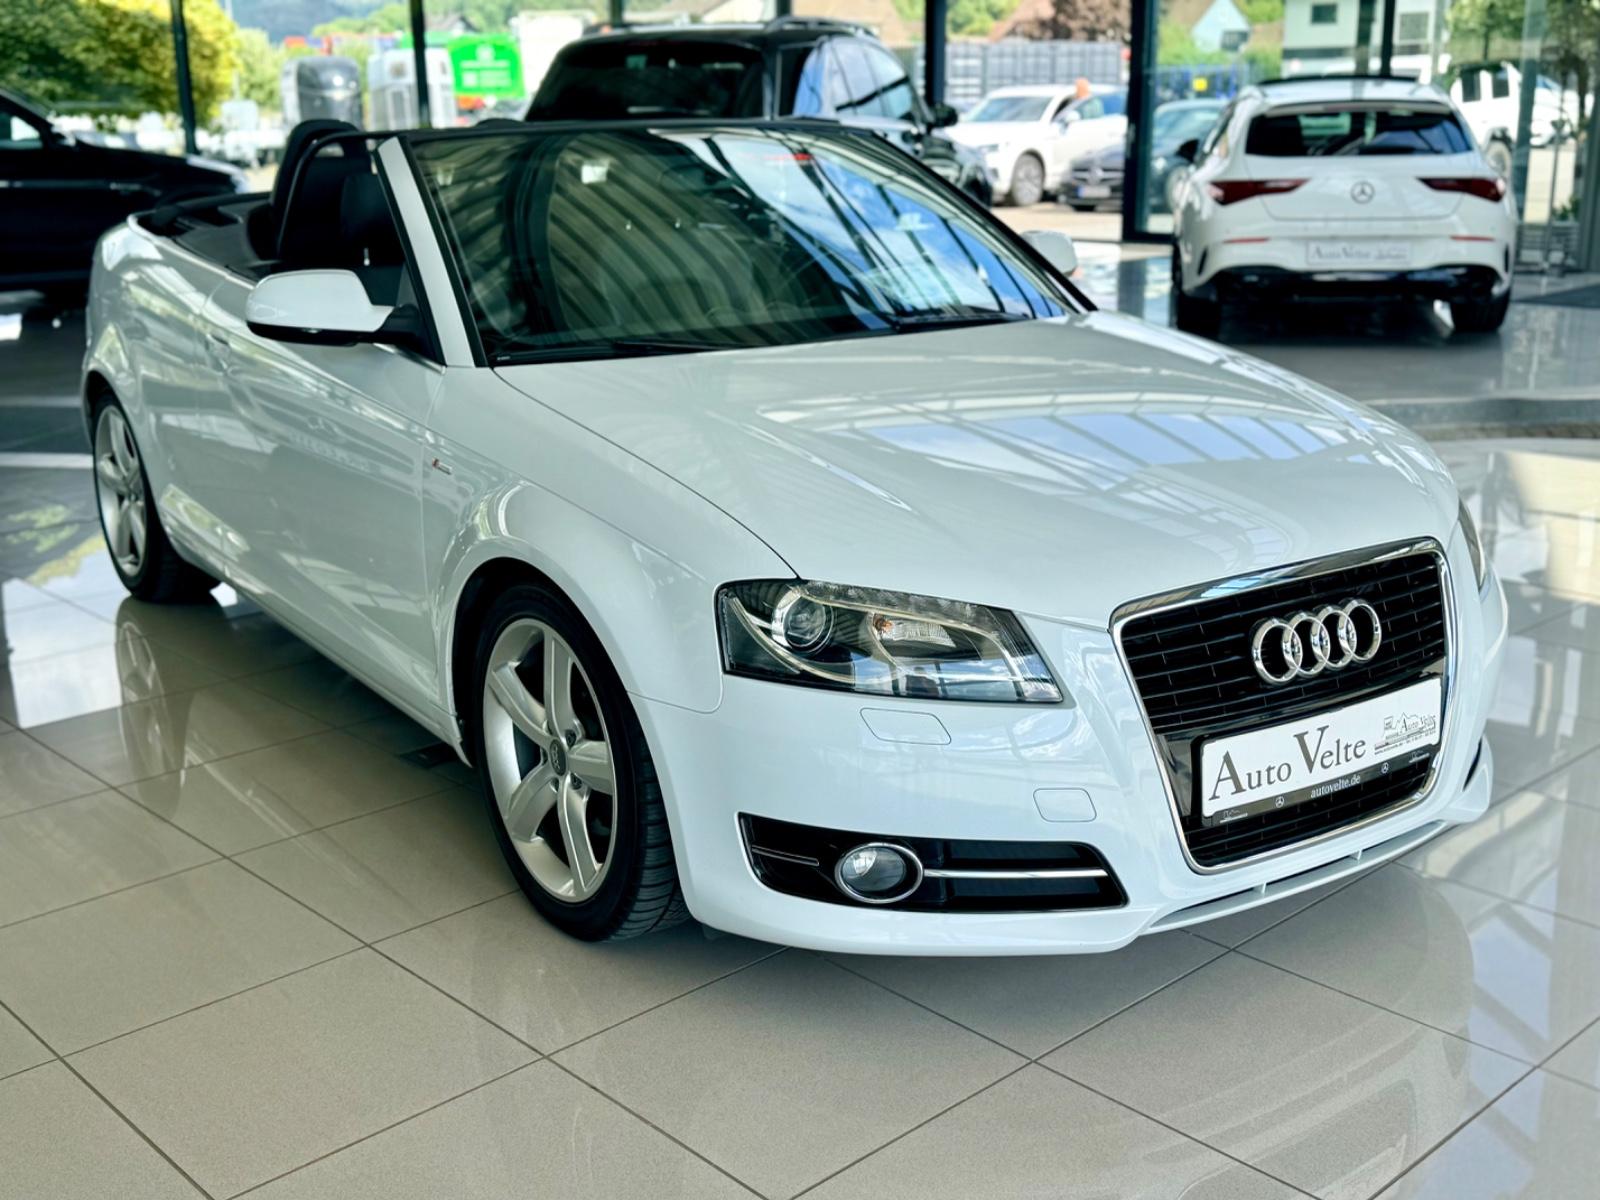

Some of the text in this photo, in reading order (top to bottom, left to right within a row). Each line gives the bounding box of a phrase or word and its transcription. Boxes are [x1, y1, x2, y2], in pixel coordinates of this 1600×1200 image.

[1209, 750, 1292, 801] Auto
[1294, 725, 1366, 774] Velte
[1310, 774, 1361, 798] autovelte.de
